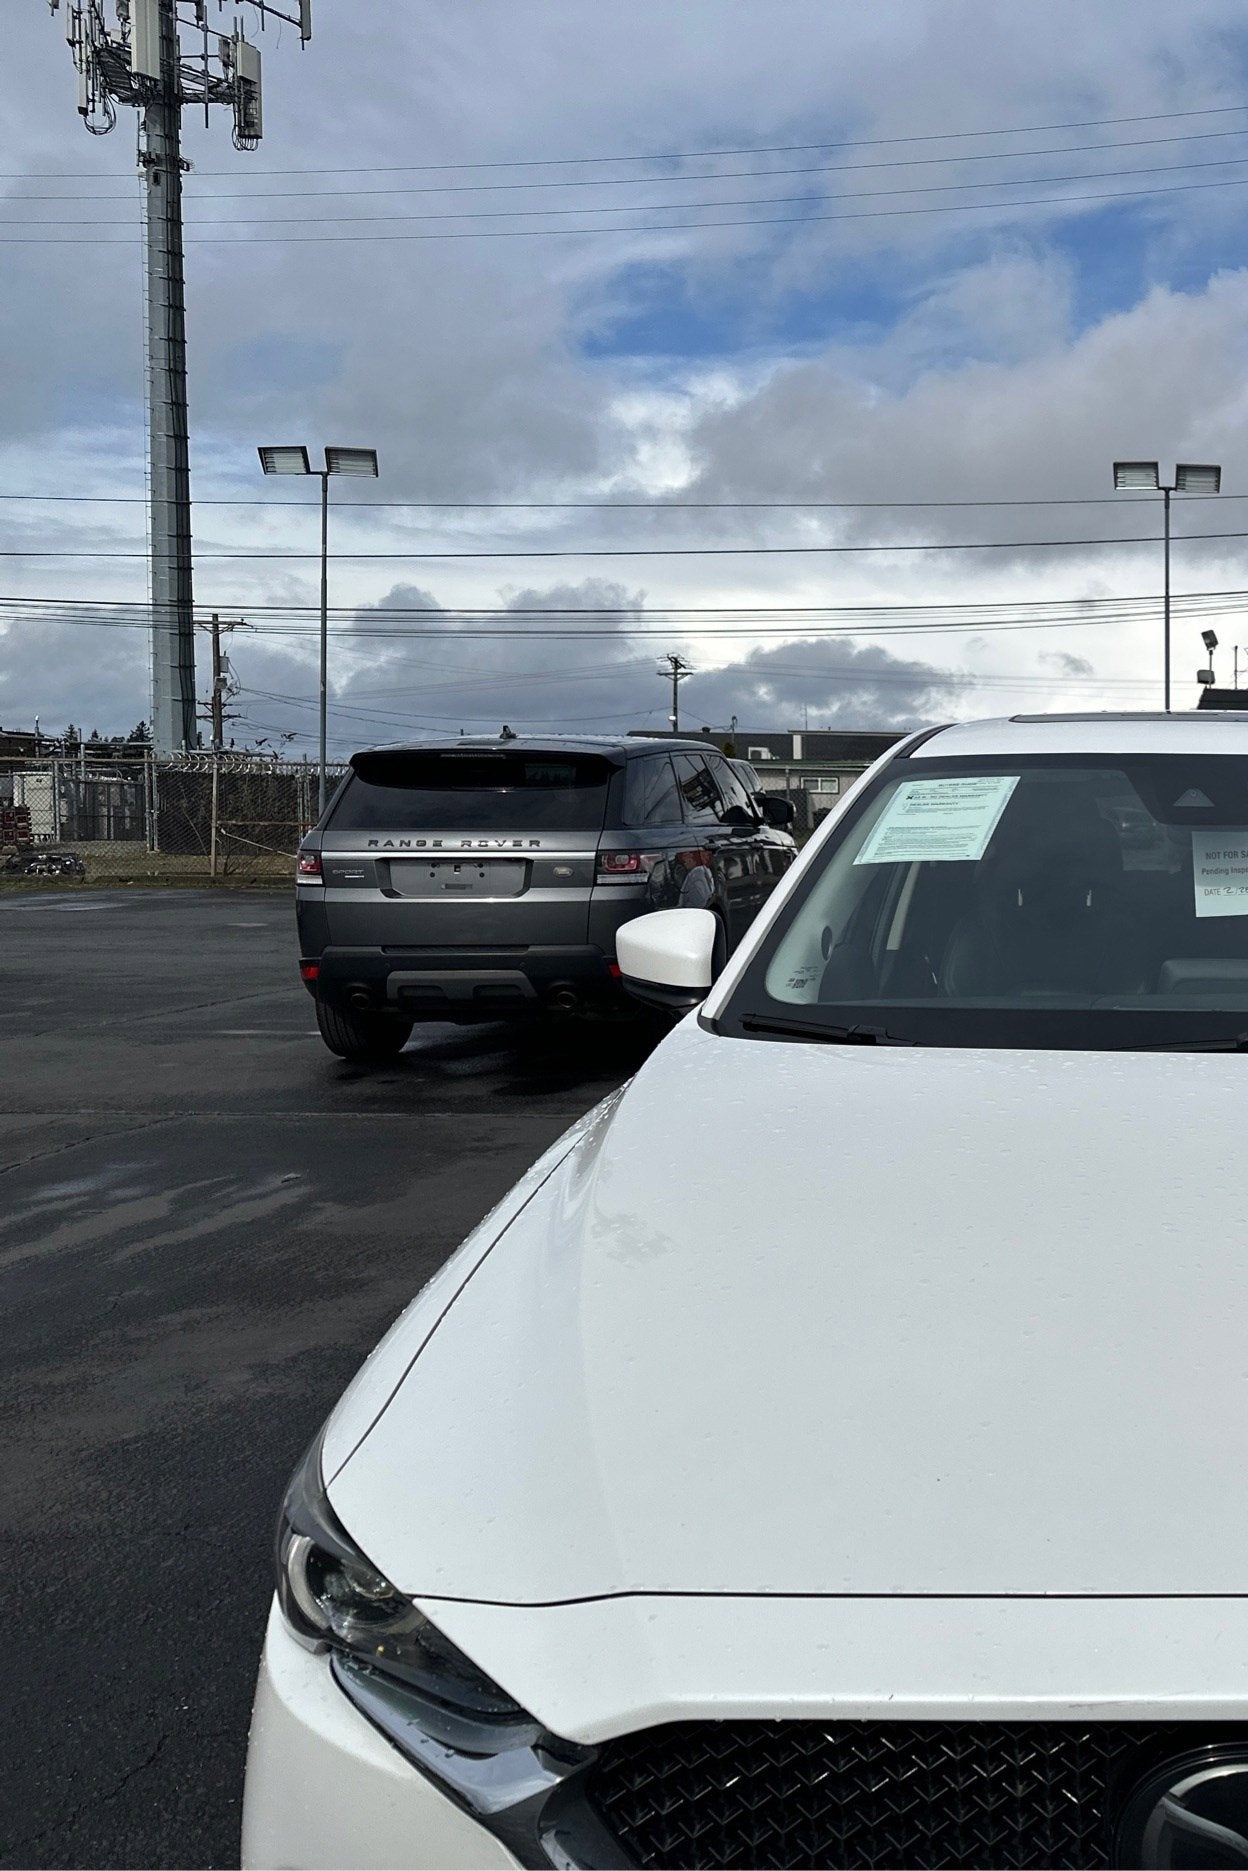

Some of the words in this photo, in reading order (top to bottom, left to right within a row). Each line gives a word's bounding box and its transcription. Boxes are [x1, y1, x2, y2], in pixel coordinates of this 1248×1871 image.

[367, 839, 444, 848] RANGE
[460, 839, 541, 848] ROVER
[1206, 851, 1221, 859] NOT
[1223, 850, 1239, 859] FOR
[1201, 867, 1229, 875] Pending
[1204, 888, 1221, 896] DATE
